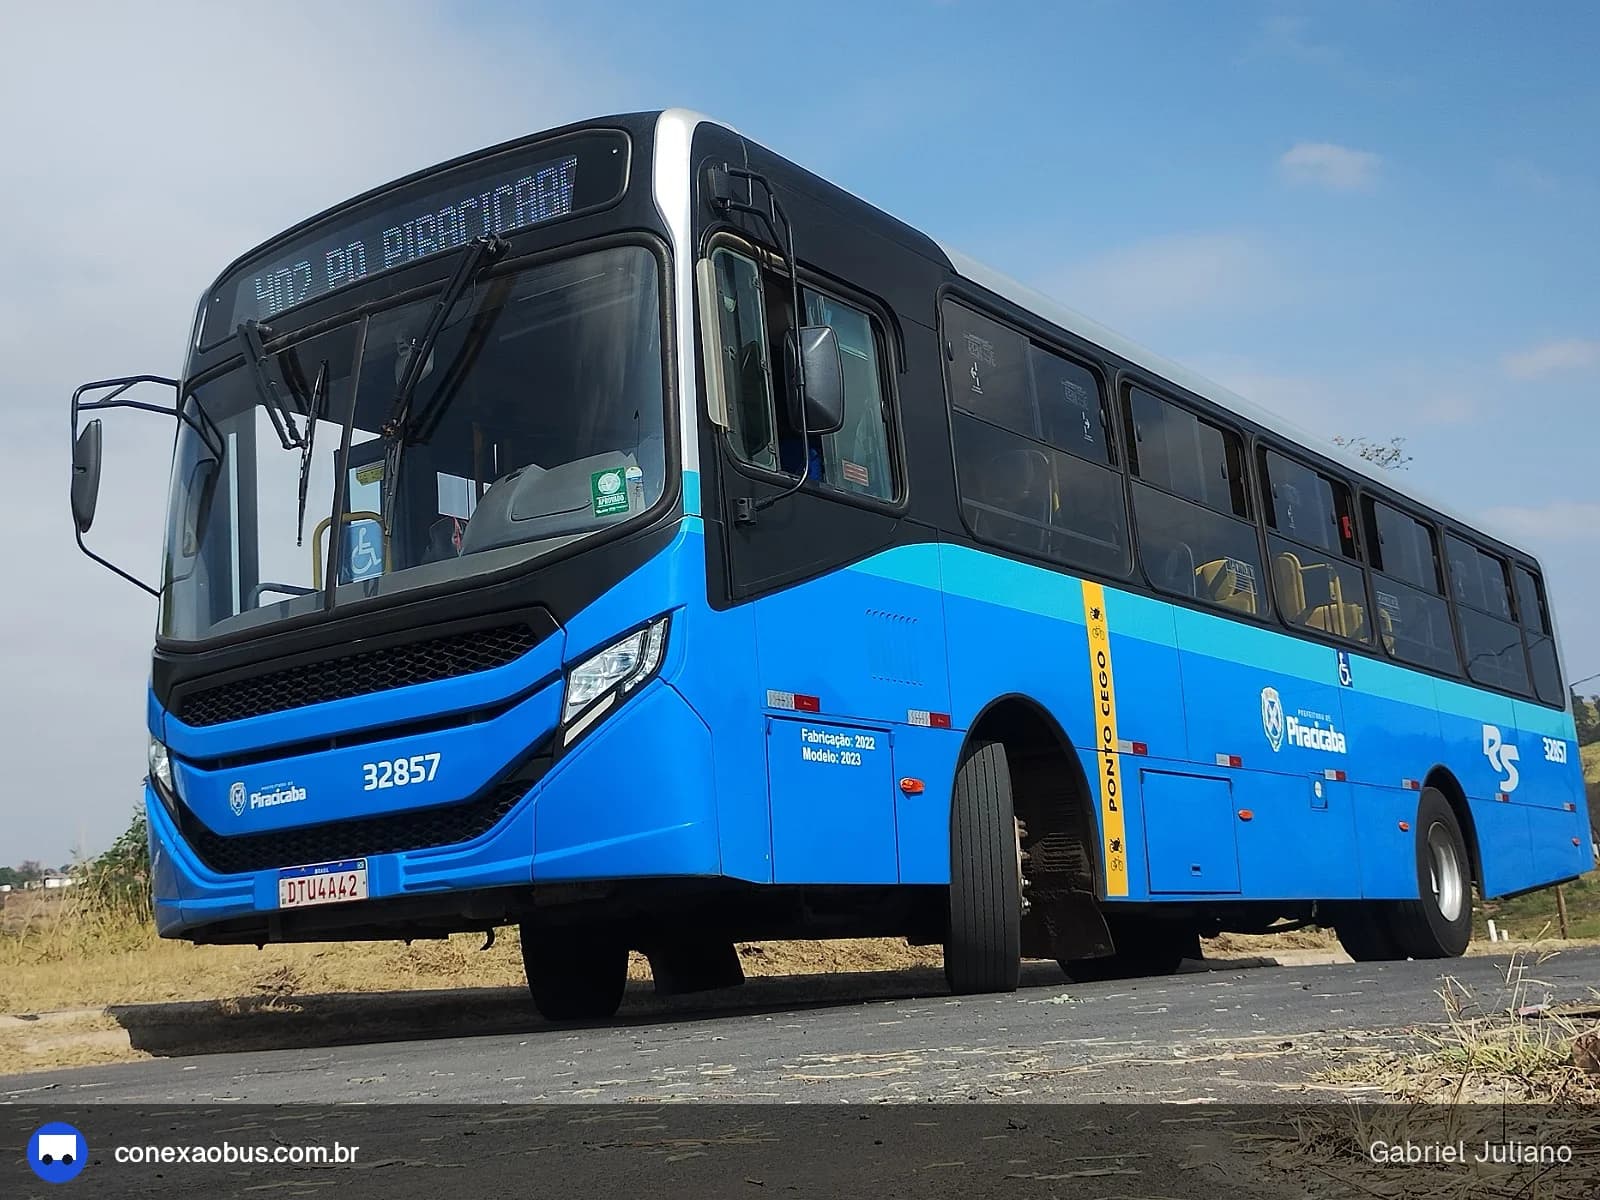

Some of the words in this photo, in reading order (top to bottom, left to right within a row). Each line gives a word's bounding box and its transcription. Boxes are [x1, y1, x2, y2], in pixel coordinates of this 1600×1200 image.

[1097, 650, 1111, 716] CEGO
[801, 728, 853, 748] Fabricação:
[854, 735, 876, 750] 2022
[1286, 716, 1347, 754] Piracicaba
[1542, 737, 1567, 764] 32857
[363, 752, 441, 791] 32857
[802, 746, 839, 764] Modelo:
[840, 751, 862, 766] 2023
[1103, 726, 1118, 812] PONTO
[1482, 724, 1520, 792] RS
[250, 785, 307, 809] Piracicaba
[288, 874, 358, 903] DTU4A42
